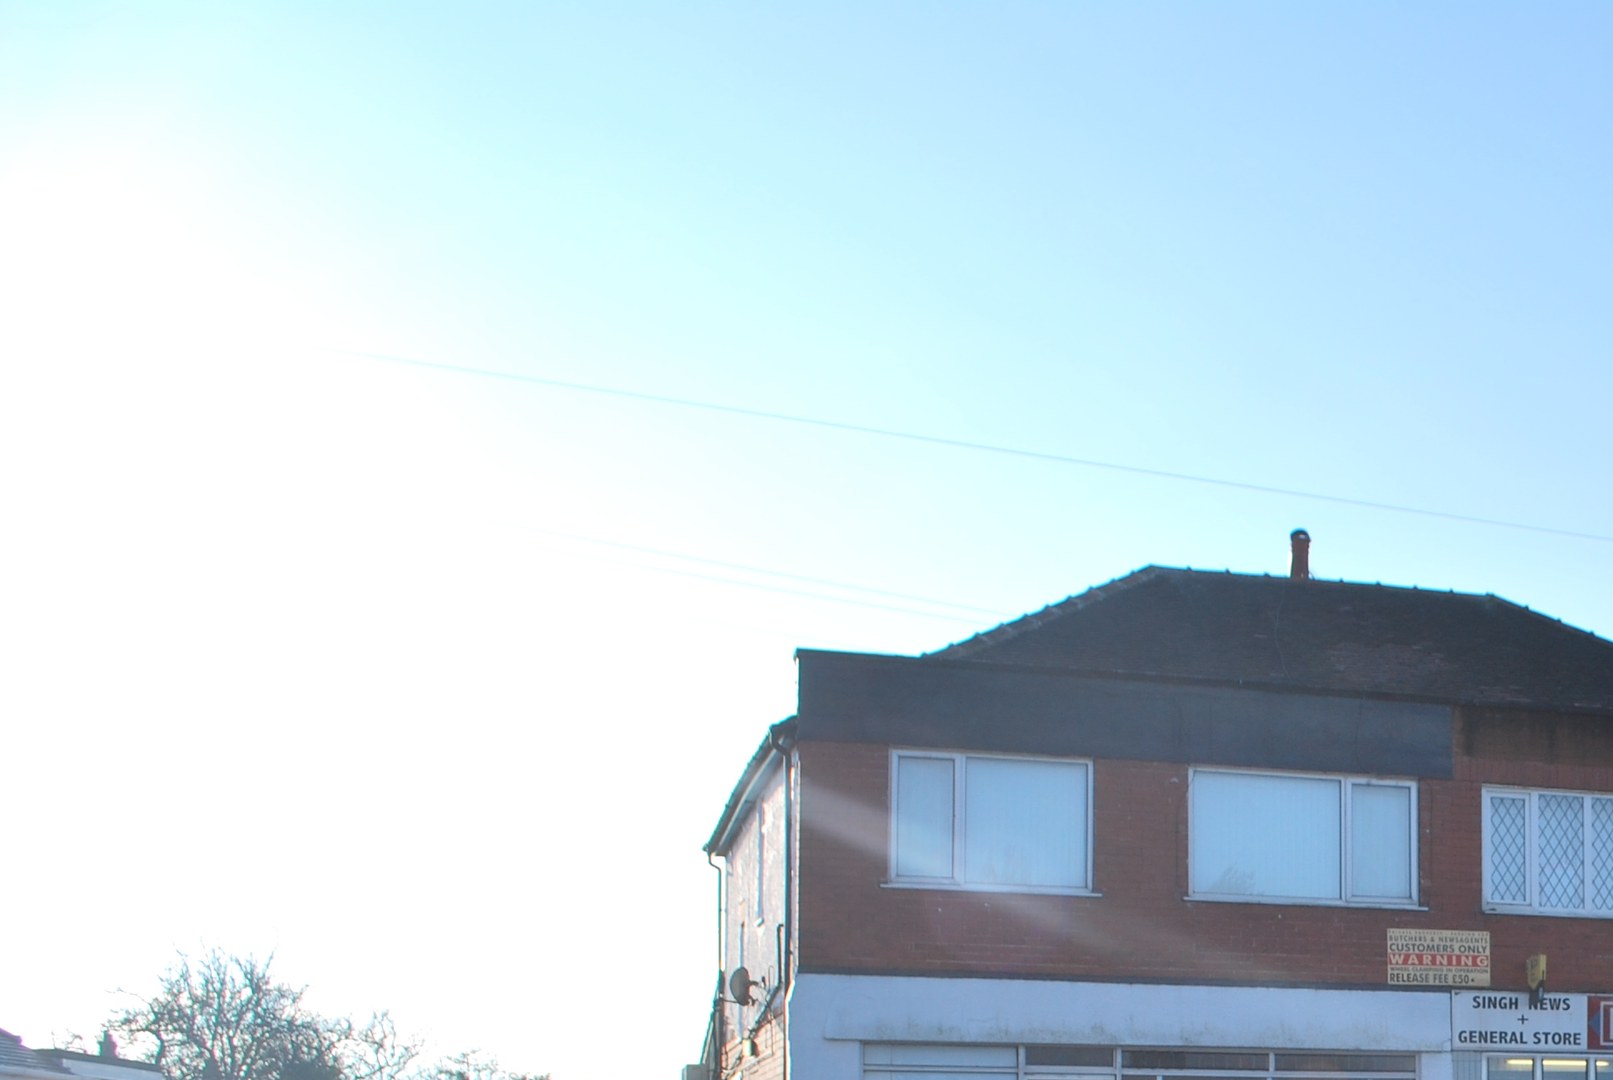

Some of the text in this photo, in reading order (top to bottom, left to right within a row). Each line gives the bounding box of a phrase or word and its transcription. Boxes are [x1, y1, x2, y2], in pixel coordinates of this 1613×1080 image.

[1440, 936, 1488, 944] NEWSAGENTS
[1389, 943, 1487, 954] CUSTOMERS ONLY
[1389, 954, 1488, 966] WARNING
[1389, 973, 1431, 983] RELEASE
[1433, 973, 1448, 983] FEE
[1472, 996, 1571, 1011] SINGH NEWS
[1458, 1030, 1582, 1045] GENERAL STORE
